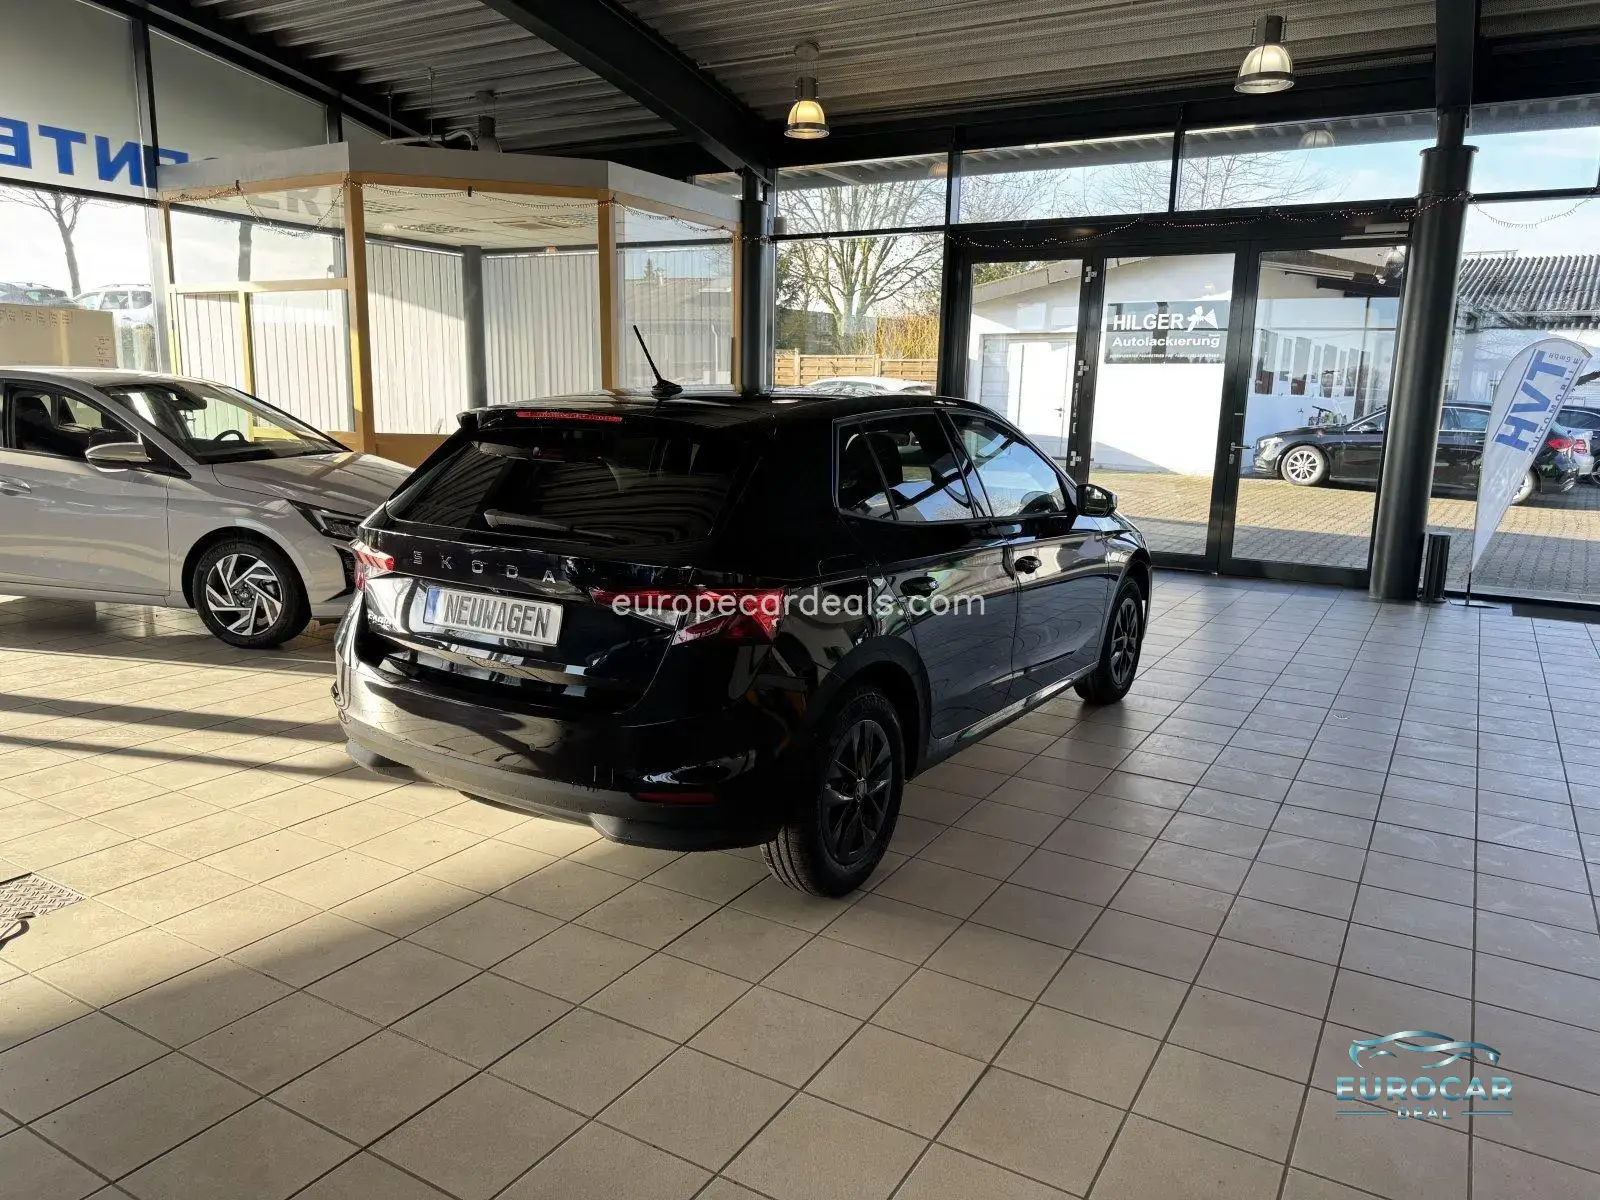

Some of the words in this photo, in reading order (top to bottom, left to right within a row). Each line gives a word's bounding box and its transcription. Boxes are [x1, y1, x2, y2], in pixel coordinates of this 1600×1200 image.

[1113, 313, 1184, 331] HILGER
[1112, 335, 1220, 348] Autolackierung
[1495, 350, 1567, 452] HVT
[444, 594, 551, 638] NEUWAGEN
